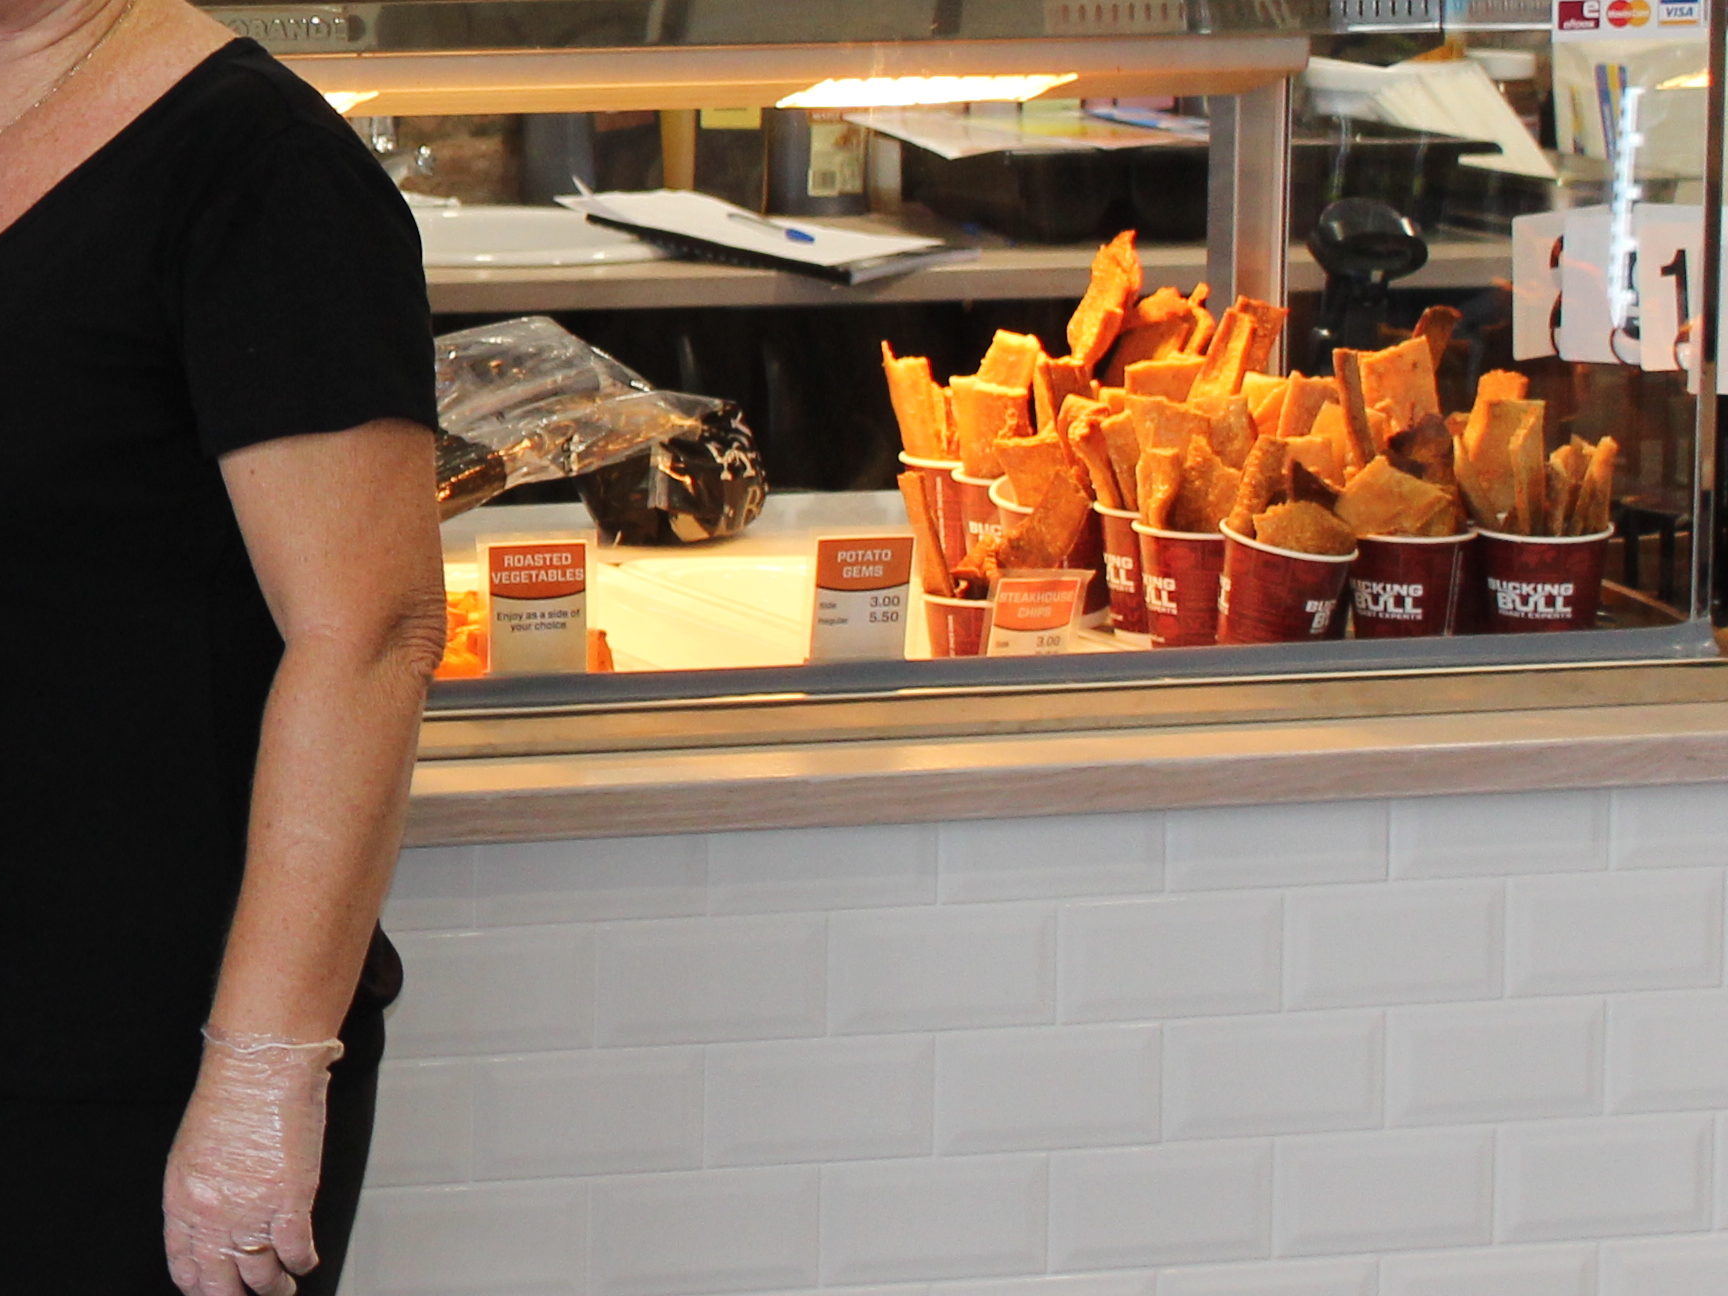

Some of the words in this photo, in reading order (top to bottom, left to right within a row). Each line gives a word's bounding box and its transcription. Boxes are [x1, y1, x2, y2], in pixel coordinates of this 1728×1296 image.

[1665, 6, 1694, 18] VISA
[504, 552, 572, 567] ROASTED
[837, 549, 892, 563] POTATO
[492, 567, 584, 584] VEGETABLES
[842, 565, 883, 579] GEMS
[1350, 577, 1423, 597] UCKING
[1487, 577, 1573, 597] BUCKING
[870, 595, 900, 607] 3.00
[1000, 590, 1074, 604] STEAKHOUSE
[1354, 591, 1422, 613] BULL
[1497, 591, 1573, 614] BULL
[497, 611, 523, 621] Enjoy
[869, 611, 899, 623] 5.50
[1017, 606, 1052, 619] CHIPS
